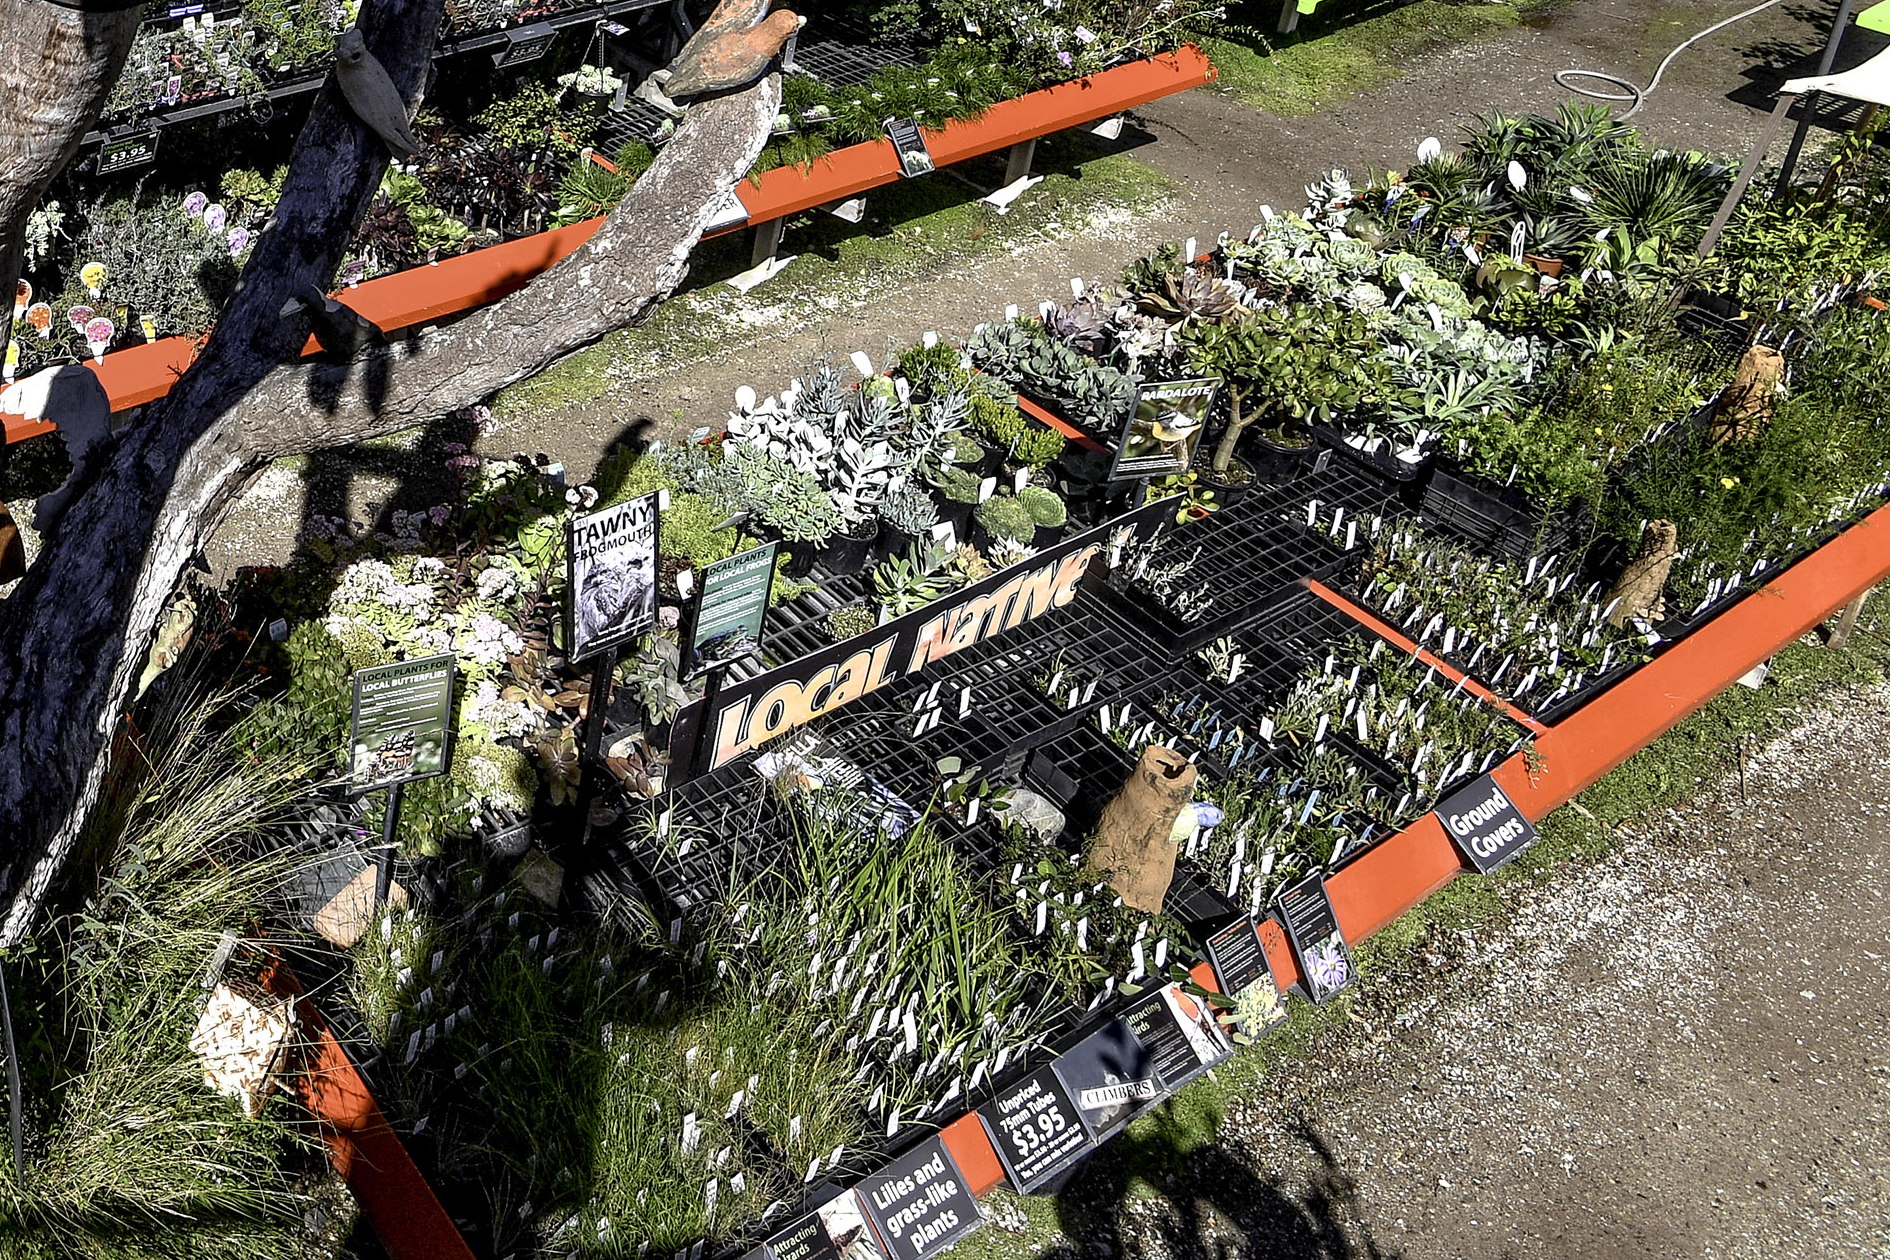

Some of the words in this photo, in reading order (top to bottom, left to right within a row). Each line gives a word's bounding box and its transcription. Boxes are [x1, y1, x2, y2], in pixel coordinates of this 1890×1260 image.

[110, 144, 146, 163] $3.95
[1141, 386, 1212, 401] PARDALOTE
[573, 503, 654, 547] TAWNY
[573, 525, 654, 564] FROGMOUTH
[733, 549, 768, 567] PLANTS
[720, 567, 746, 581] LOCAL
[745, 556, 772, 573] FROGS
[361, 680, 391, 693] LOCAL
[391, 669, 448, 687] BUTTERFLIES
[362, 672, 392, 683] LOCAL
[394, 663, 429, 677] PLANTS
[430, 660, 449, 670] FOR
[1449, 786, 1509, 836] Ground
[1470, 817, 1525, 858] Covers
[998, 1078, 1043, 1114] Unpriced
[1086, 1081, 1151, 1104] CLIMBERS
[999, 1108, 1031, 1134] 75mm
[1026, 1091, 1057, 1115] Tubes
[1012, 1105, 1066, 1157] $3.95
[872, 1174, 915, 1211] Lilies
[914, 1151, 946, 1186] and
[885, 1178, 958, 1239] grass-like
[772, 1223, 819, 1257] Attracting
[909, 1208, 960, 1255] plants
